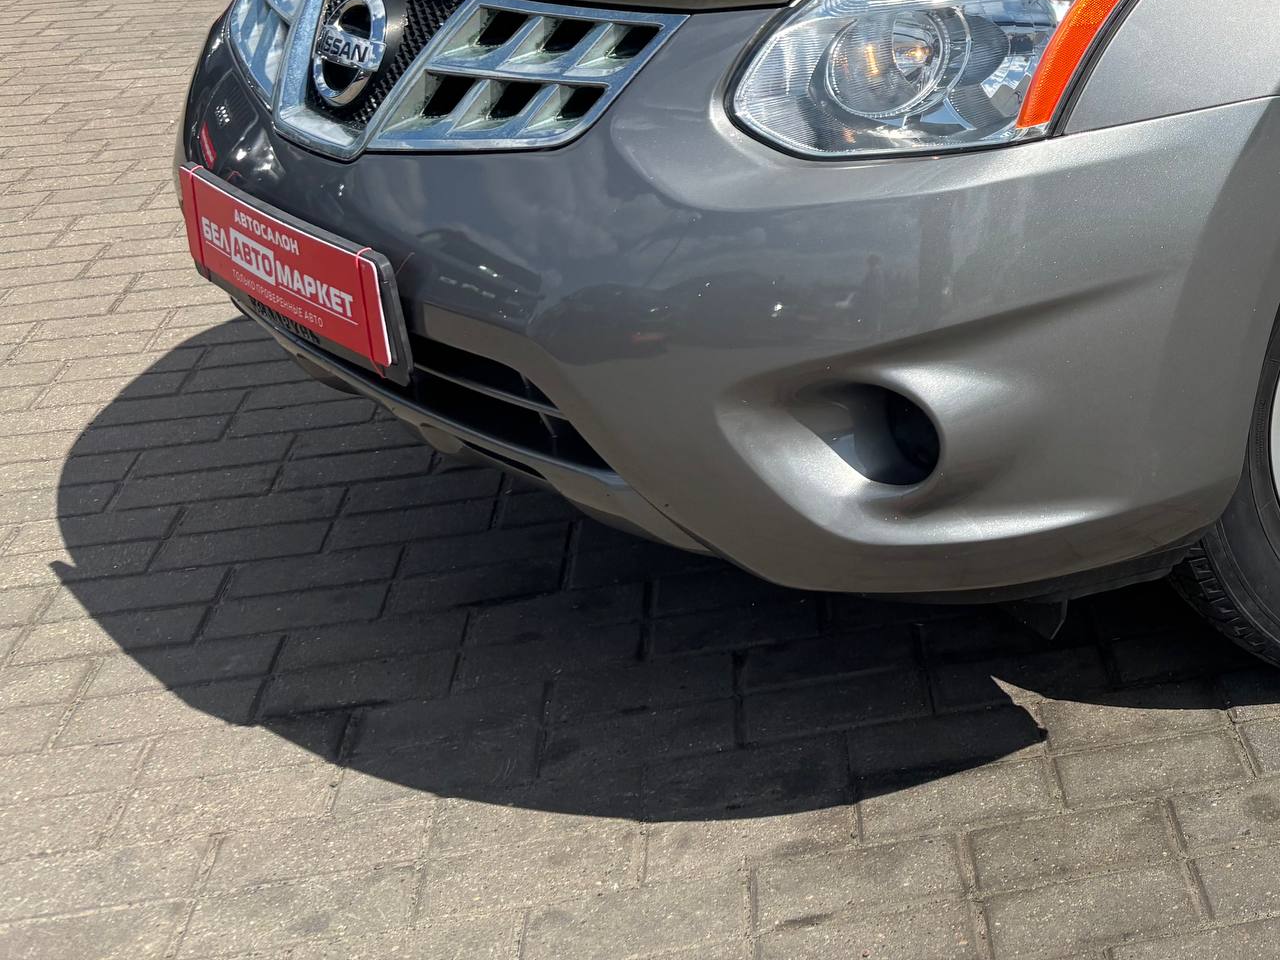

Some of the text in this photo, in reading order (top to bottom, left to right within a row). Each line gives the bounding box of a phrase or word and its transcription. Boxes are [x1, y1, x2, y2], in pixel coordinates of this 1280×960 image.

[234, 209, 299, 256] АВТОСАЛОН
[201, 216, 231, 252] БЕЛ
[275, 260, 354, 318] МАРКЕТ
[304, 311, 324, 328] АВТО
